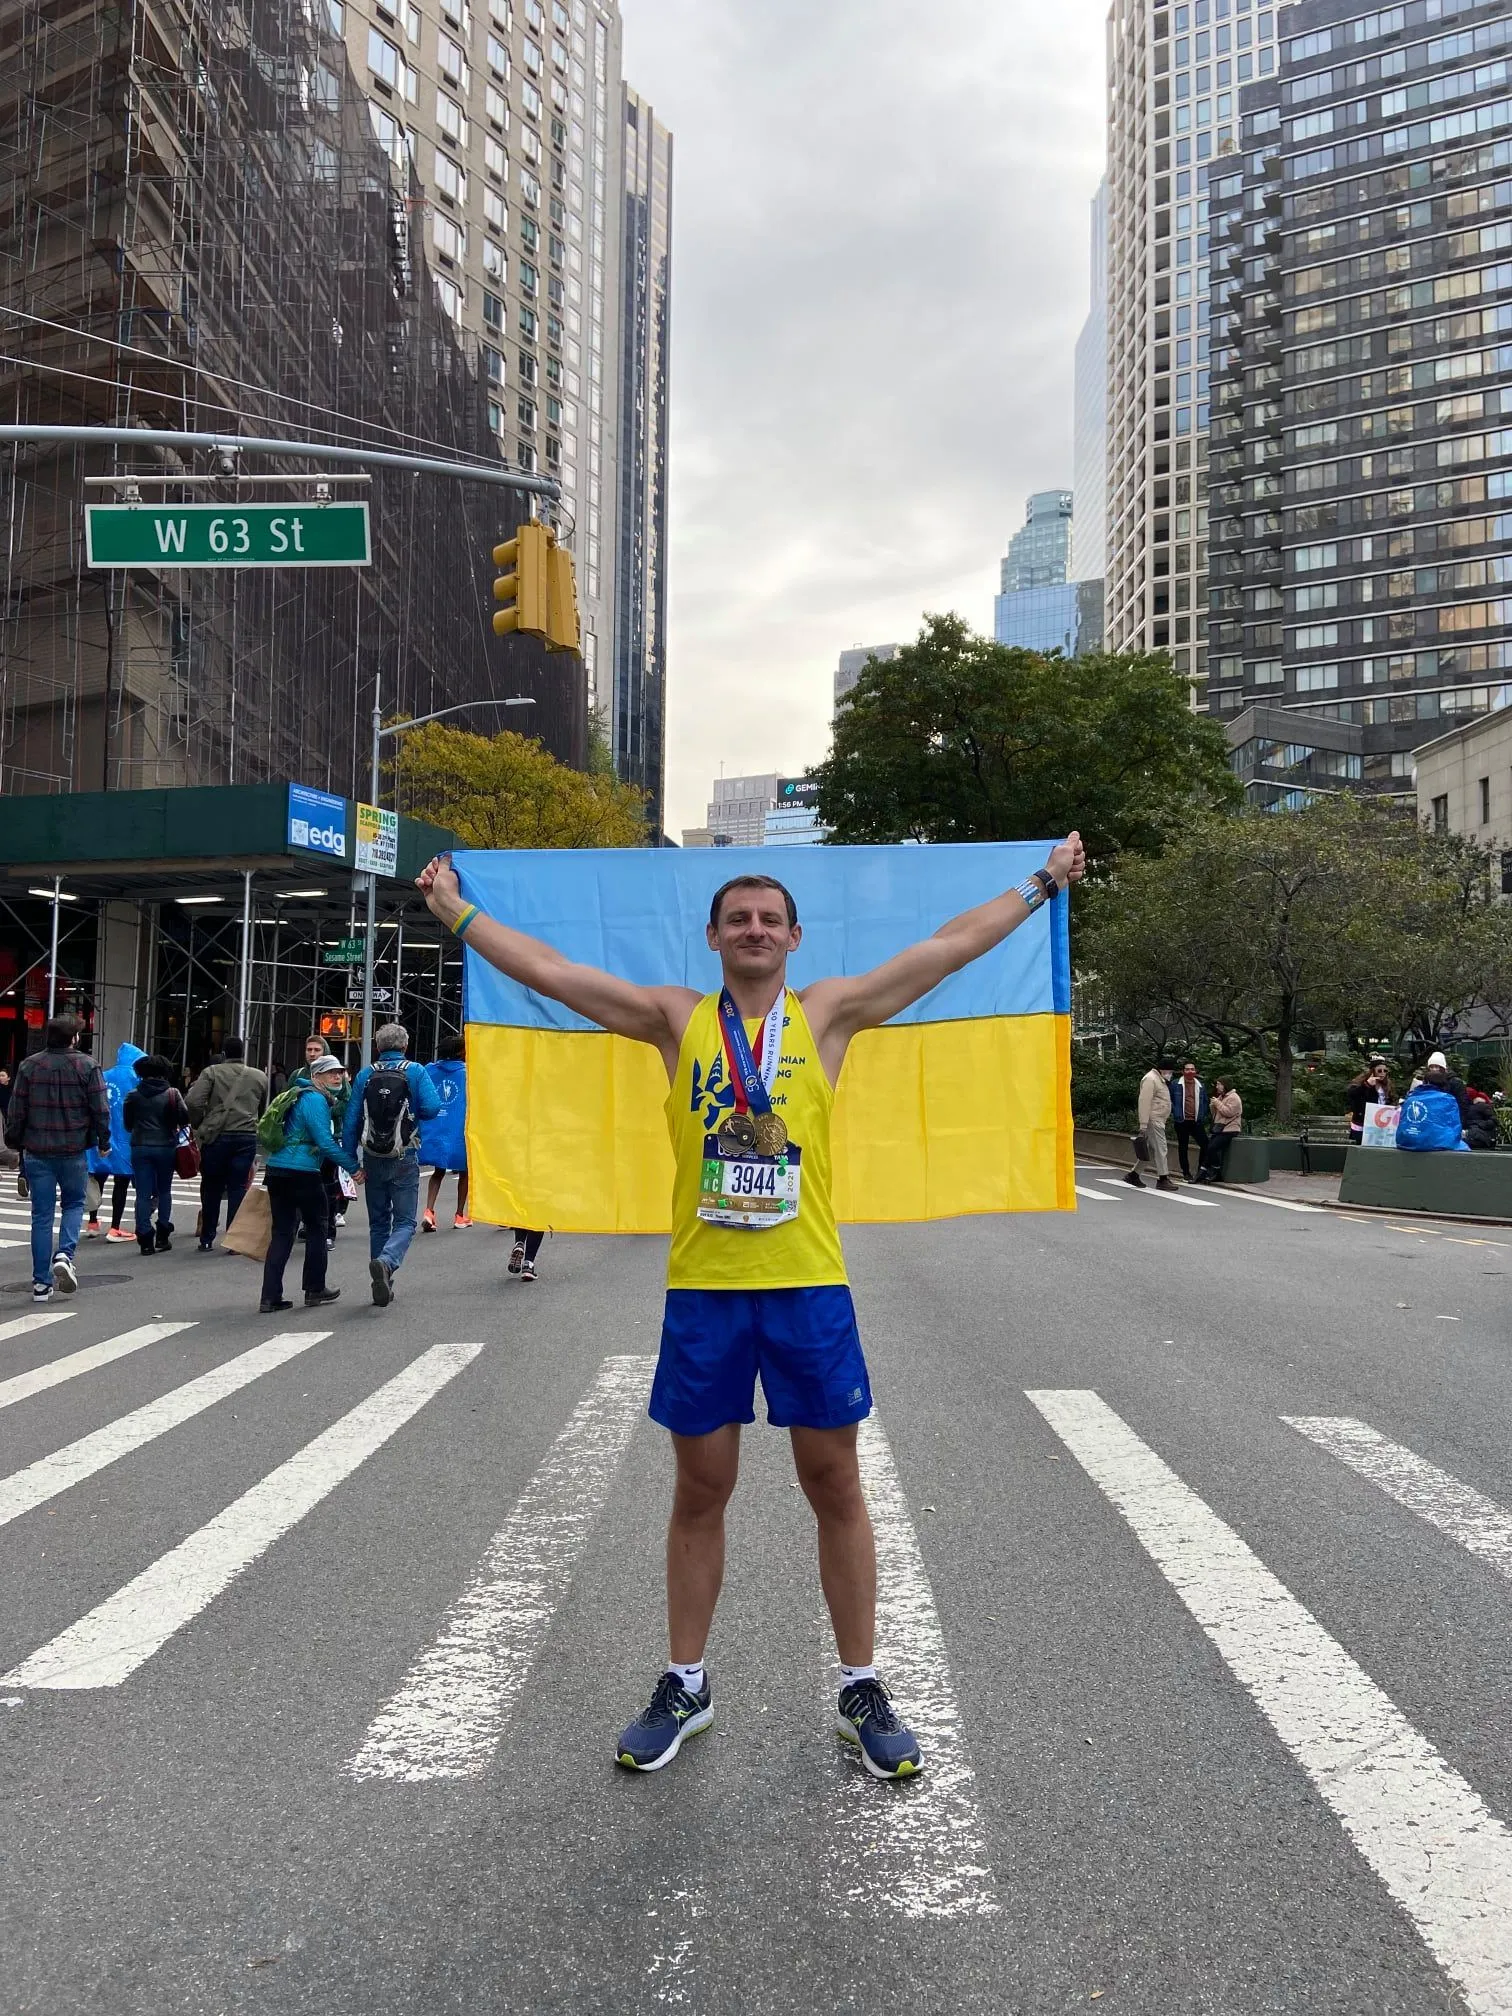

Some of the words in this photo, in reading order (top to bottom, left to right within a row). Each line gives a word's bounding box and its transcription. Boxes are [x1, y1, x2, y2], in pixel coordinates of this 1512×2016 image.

[154, 519, 187, 553] W
[208, 518, 250, 553] 63
[270, 517, 305, 553] St
[778, 801, 791, 809] 1:56
[360, 808, 396, 827] SPRING
[310, 825, 345, 858] edg
[341, 940, 346, 949] W
[348, 940, 356, 949] 63
[325, 952, 345, 962] Sesame
[346, 952, 363, 962] Street
[353, 991, 363, 999] ON
[373, 991, 387, 999] WAY
[711, 1178, 719, 1193] C
[731, 1164, 776, 1196] 3944
